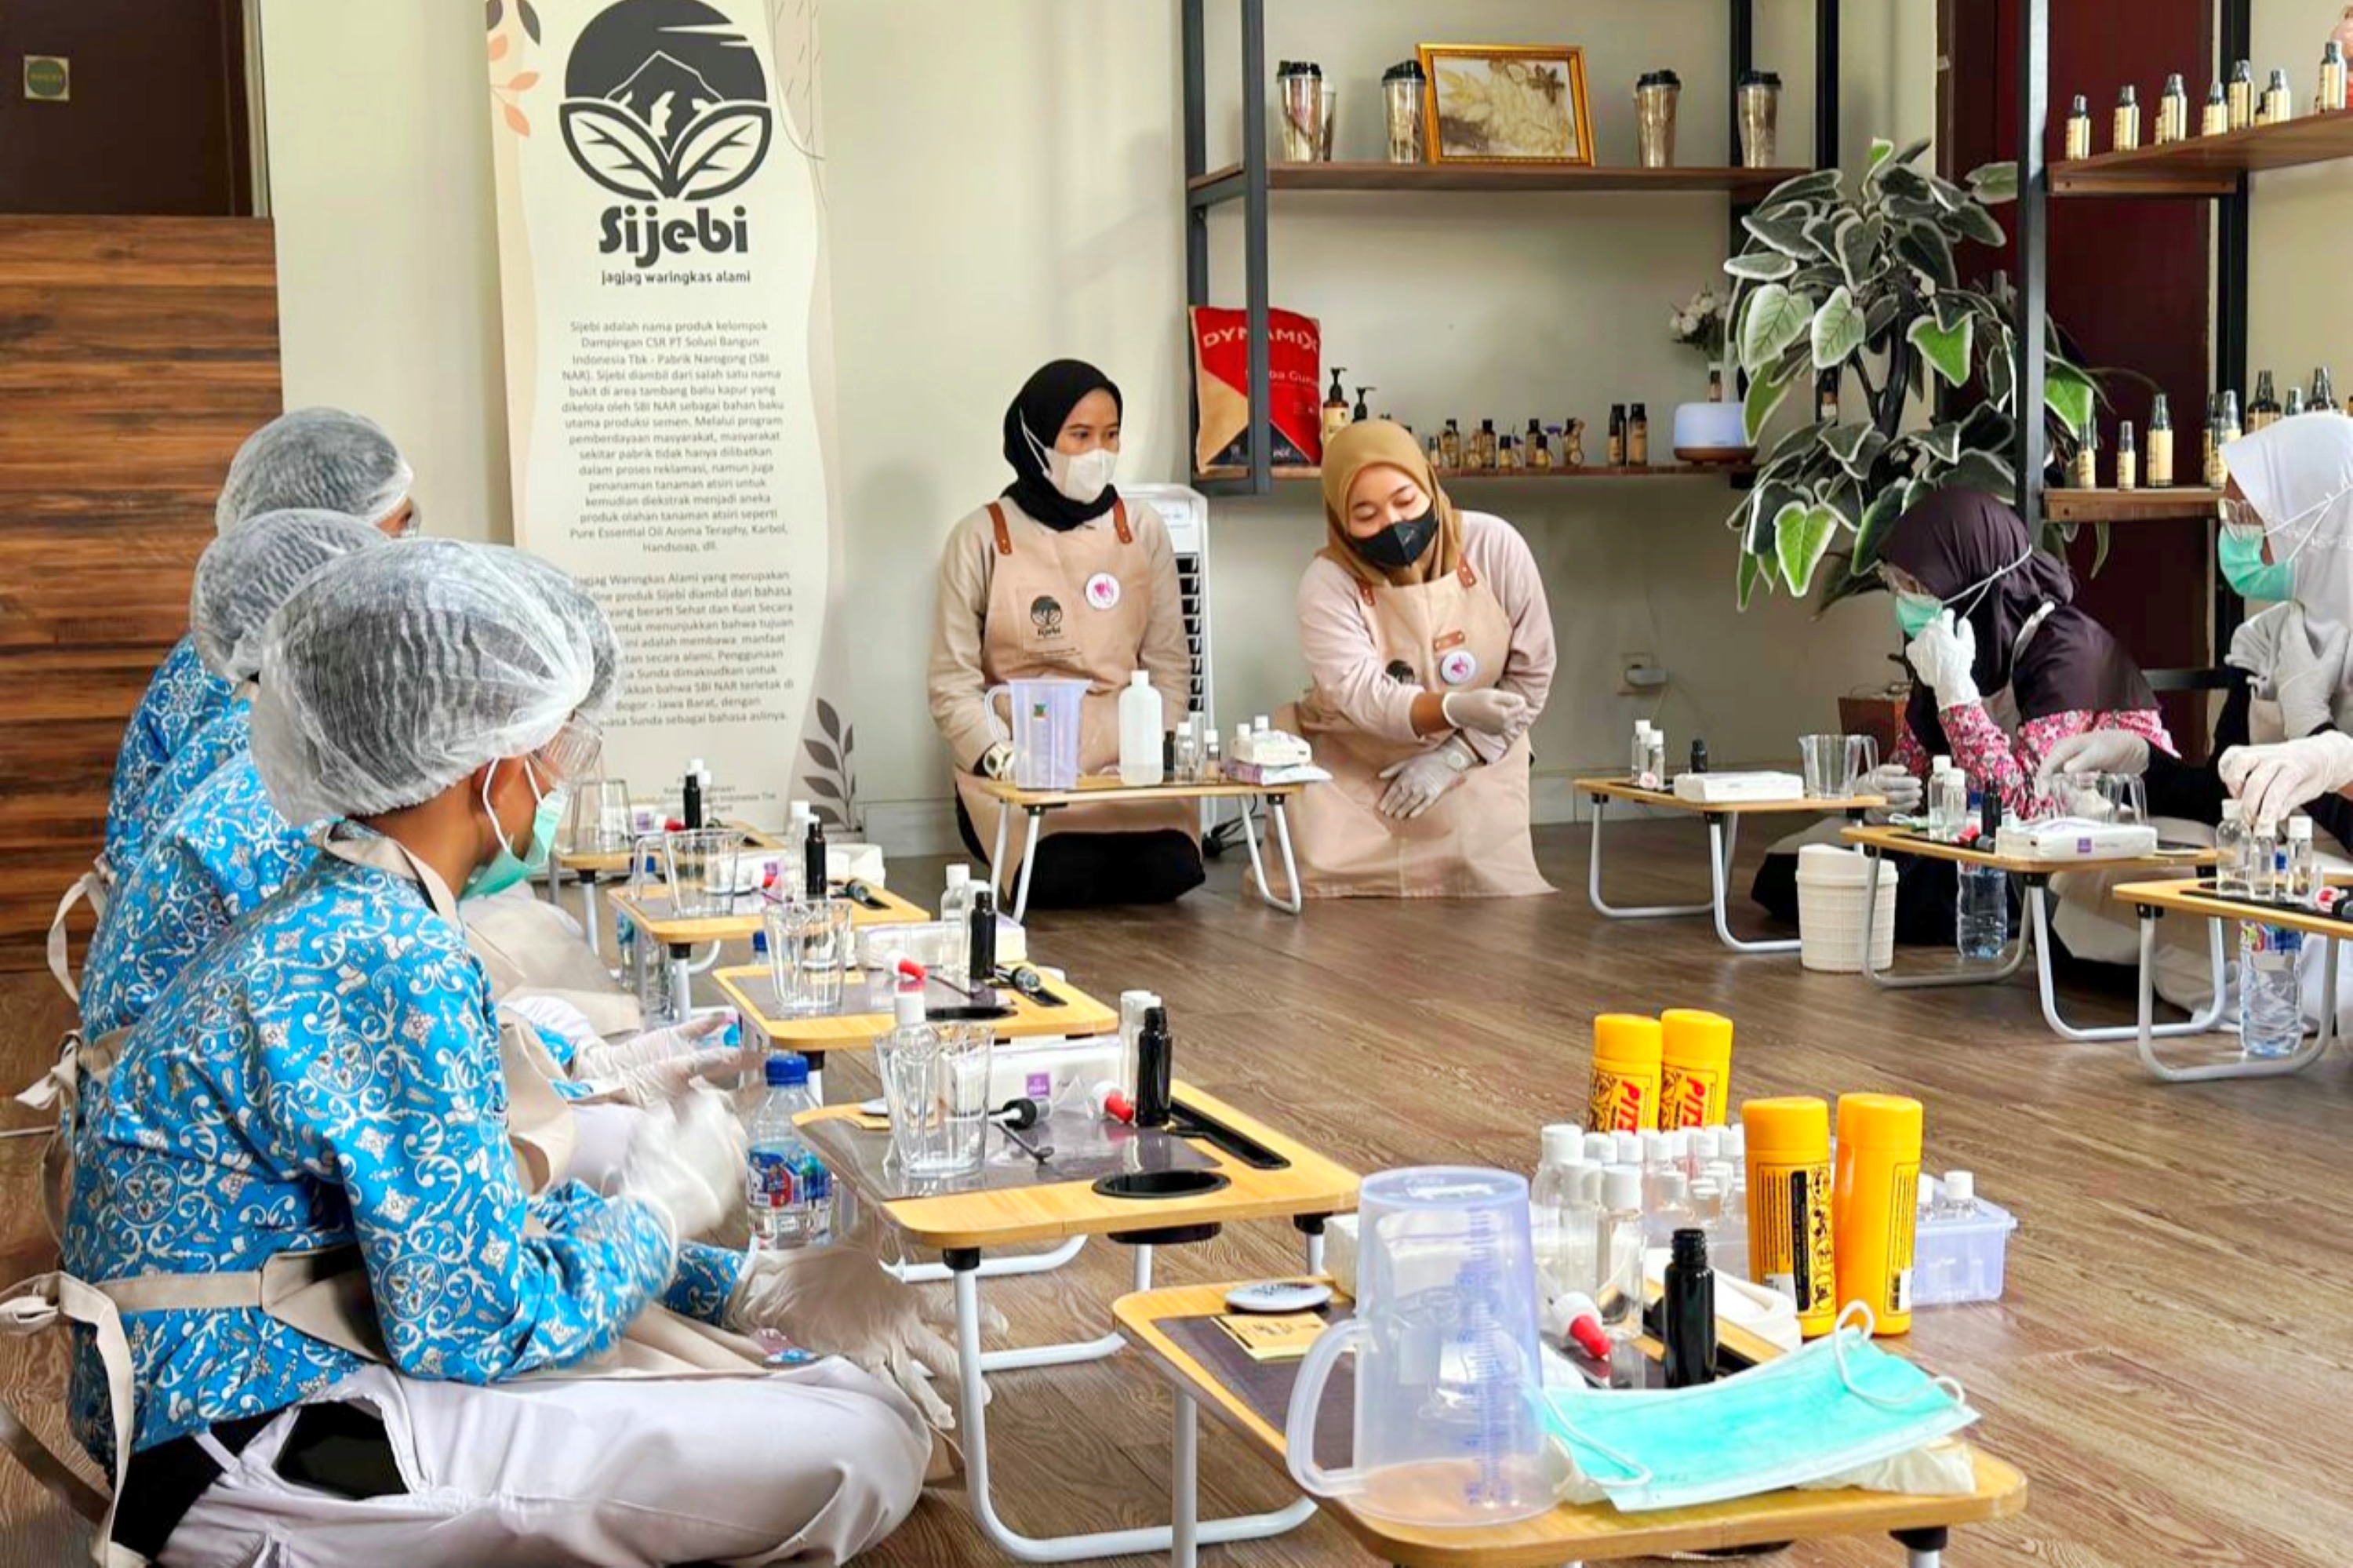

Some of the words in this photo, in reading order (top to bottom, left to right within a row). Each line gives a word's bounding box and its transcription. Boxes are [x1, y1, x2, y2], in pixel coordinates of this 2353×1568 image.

[598, 205, 748, 268] Sijebi
[602, 270, 642, 286] jagjag
[644, 270, 713, 286] waringkas
[715, 270, 751, 283] alami
[570, 321, 600, 334] Sijebi
[602, 320, 639, 331] adalah
[642, 322, 672, 331] nama
[675, 320, 713, 333] produk
[715, 319, 767, 333] kelompok
[580, 337, 643, 350] Dampingan
[645, 337, 666, 347] CSR
[668, 336, 682, 347] PT
[684, 336, 717, 347] Solusi
[718, 336, 759, 349] Bangun
[572, 353, 626, 365] Indonesia
[627, 353, 647, 364] Tbk
[657, 353, 691, 364] Pabrik
[693, 352, 746, 366] Narogong
[596, 369, 625, 383] Sijebi
[627, 369, 668, 380] diambil
[671, 369, 693, 380] dari
[694, 369, 723, 379] salah
[725, 368, 748, 379] satu
[751, 370, 780, 379] nama
[569, 386, 597, 396] bukit
[599, 385, 610, 396] di
[613, 387, 637, 396] area
[638, 384, 687, 398] tambang
[689, 384, 715, 395] batu
[717, 384, 747, 398] kapur
[750, 386, 776, 397] yang
[561, 401, 604, 413] dikelola
[606, 401, 631, 412] oleh
[633, 401, 650, 412] SBI
[653, 400, 676, 411] NAR
[679, 400, 720, 413] sebagai
[722, 399, 755, 410] bahan
[758, 399, 784, 410] baku
[565, 417, 601, 427] utama
[602, 417, 649, 430] produksi
[694, 416, 735, 427] Melalui
[737, 417, 783, 429] program
[569, 432, 650, 446] pemberdayaan
[719, 431, 779, 445] masyarakat
[579, 448, 616, 459] sekitar
[618, 448, 653, 461] pabrik
[655, 447, 682, 458] tidak
[684, 447, 718, 460] hanya
[719, 446, 772, 457] dilibatkan
[578, 464, 613, 475] dalam
[615, 466, 651, 477] proses
[711, 464, 749, 473] namun
[751, 462, 773, 475] juga
[588, 482, 653, 493] penanaman
[655, 478, 704, 489] tanaman
[706, 478, 733, 489] atsiri
[735, 478, 766, 489] untuk
[585, 495, 638, 506] kemudian
[641, 494, 690, 506] diekstrak
[692, 494, 736, 508] menjadi
[739, 493, 770, 504] aneka
[580, 511, 619, 525] produk
[620, 510, 658, 522] olahan
[660, 509, 709, 521] tanaman
[711, 509, 738, 520] atsiri
[740, 508, 777, 522] seperti
[569, 527, 595, 539] Pure
[598, 526, 645, 538] Essential
[647, 526, 663, 537] Oil
[665, 526, 702, 537] Aroma
[609, 573, 665, 588] Waringkas
[667, 572, 698, 583] Alami
[701, 573, 727, 585] yang
[729, 569, 790, 584] merupakan
[615, 589, 653, 603] produk
[656, 588, 686, 602] Sijebi
[688, 588, 728, 599] diambil
[730, 587, 751, 598] dari
[754, 586, 791, 598] bahasa
[636, 604, 673, 616] berarti
[675, 603, 706, 615] Sehat
[708, 603, 729, 614] dan
[732, 602, 755, 613] Kuat
[758, 602, 793, 613] Secara
[645, 620, 718, 635] menunjukkan
[721, 618, 757, 630] bahwa
[758, 617, 793, 631] tujuan
[679, 635, 736, 646] membawa
[741, 633, 785, 645] manfaat
[646, 654, 680, 664] secara
[717, 649, 784, 664] Penggunaan
[636, 667, 670, 678] Sunda
[671, 664, 744, 678] dimaksudkan
[745, 664, 777, 675] untuk
[655, 682, 692, 693] bahwa
[740, 679, 780, 691] terletak
[657, 697, 683, 708] Jawa
[720, 695, 760, 709] dengan
[629, 715, 663, 726] Sunda
[665, 713, 706, 728] sebagai
[708, 711, 746, 723] bahasa
